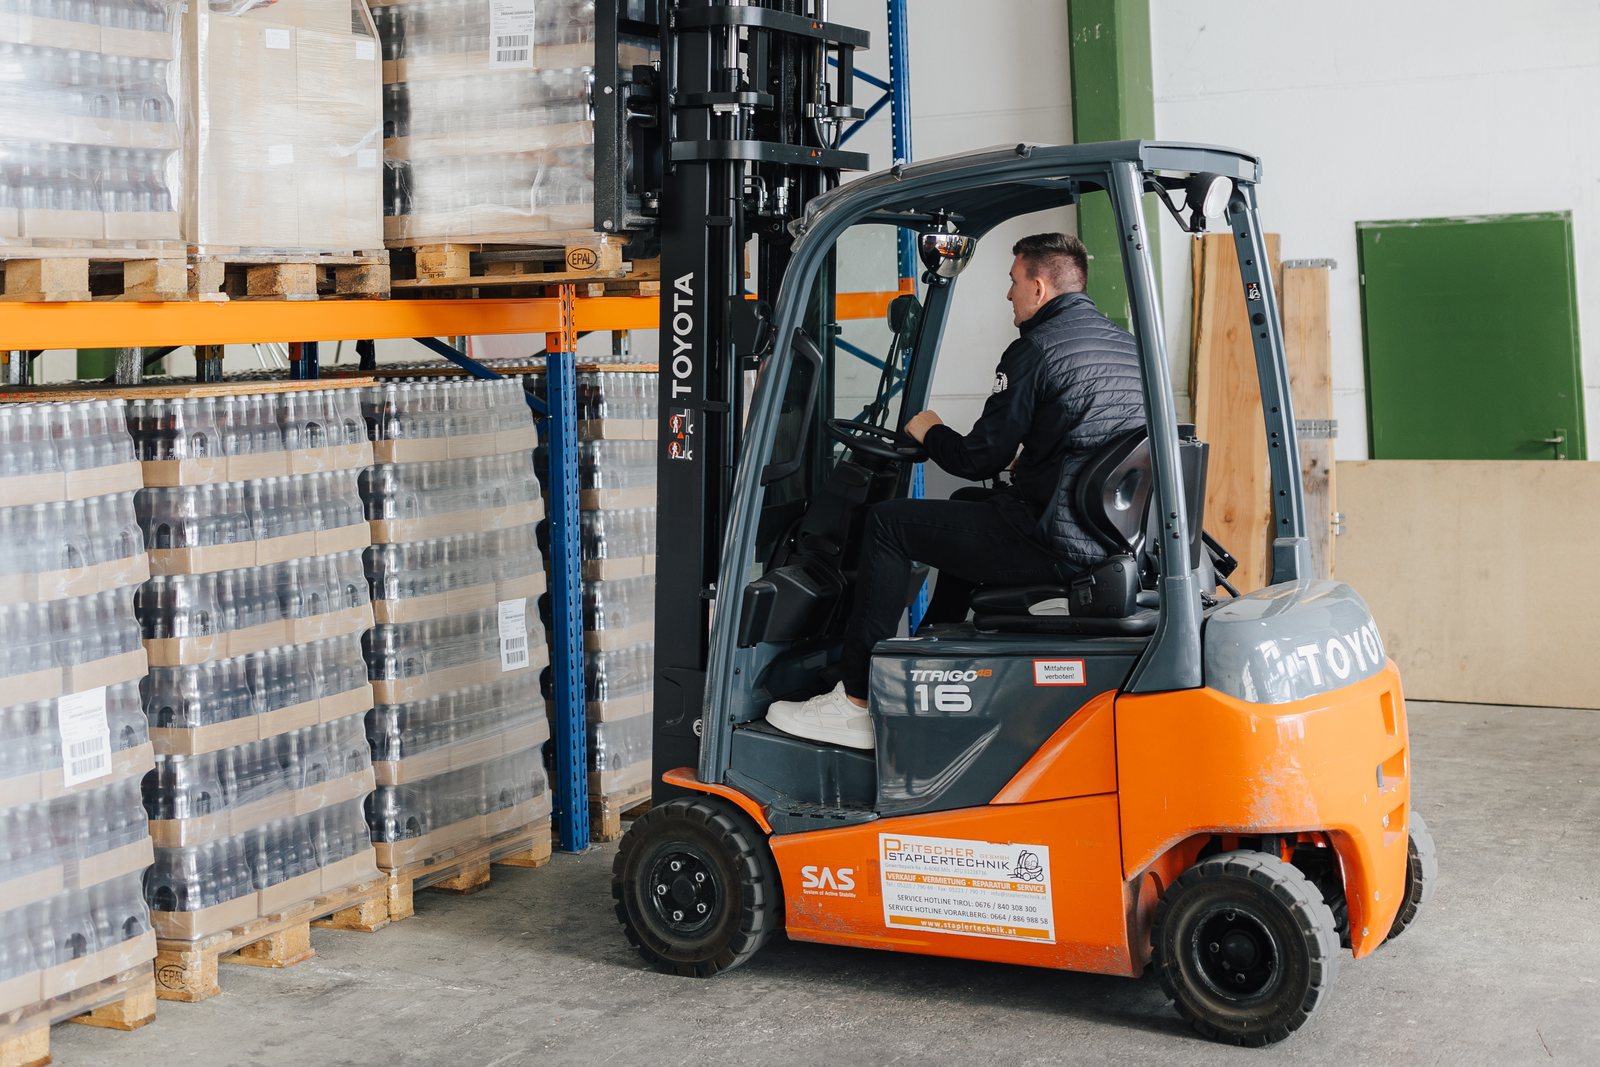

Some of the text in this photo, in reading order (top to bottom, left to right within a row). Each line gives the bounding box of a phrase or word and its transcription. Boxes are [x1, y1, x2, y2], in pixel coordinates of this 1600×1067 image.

[572, 253, 593, 265] EPAL
[672, 272, 694, 399] TOYOTA
[915, 684, 972, 712] 16
[884, 838, 974, 860] PFITSCHER
[888, 852, 1010, 871] STAPLERTECHNIK
[801, 865, 855, 891] SAS
[887, 872, 1045, 893] VERKAUF VERMIETUNG REPARATUR SERVICE
[888, 903, 913, 912] SERVICE
[914, 906, 942, 915] HOTLINE
[943, 909, 989, 919] VORARLBERG:
[990, 913, 1007, 921] 0664
[1012, 914, 1026, 923] 886
[1026, 916, 1039, 924] 988
[897, 894, 922, 903] SERVICE
[924, 898, 951, 906] HOTLINE
[953, 899, 974, 908] TIROL:
[975, 901, 991, 909] 0676
[997, 903, 1010, 911] 840
[1011, 904, 1023, 912] 308
[1025, 905, 1037, 913] 300
[920, 920, 1017, 935] www.staplertechnik.at
